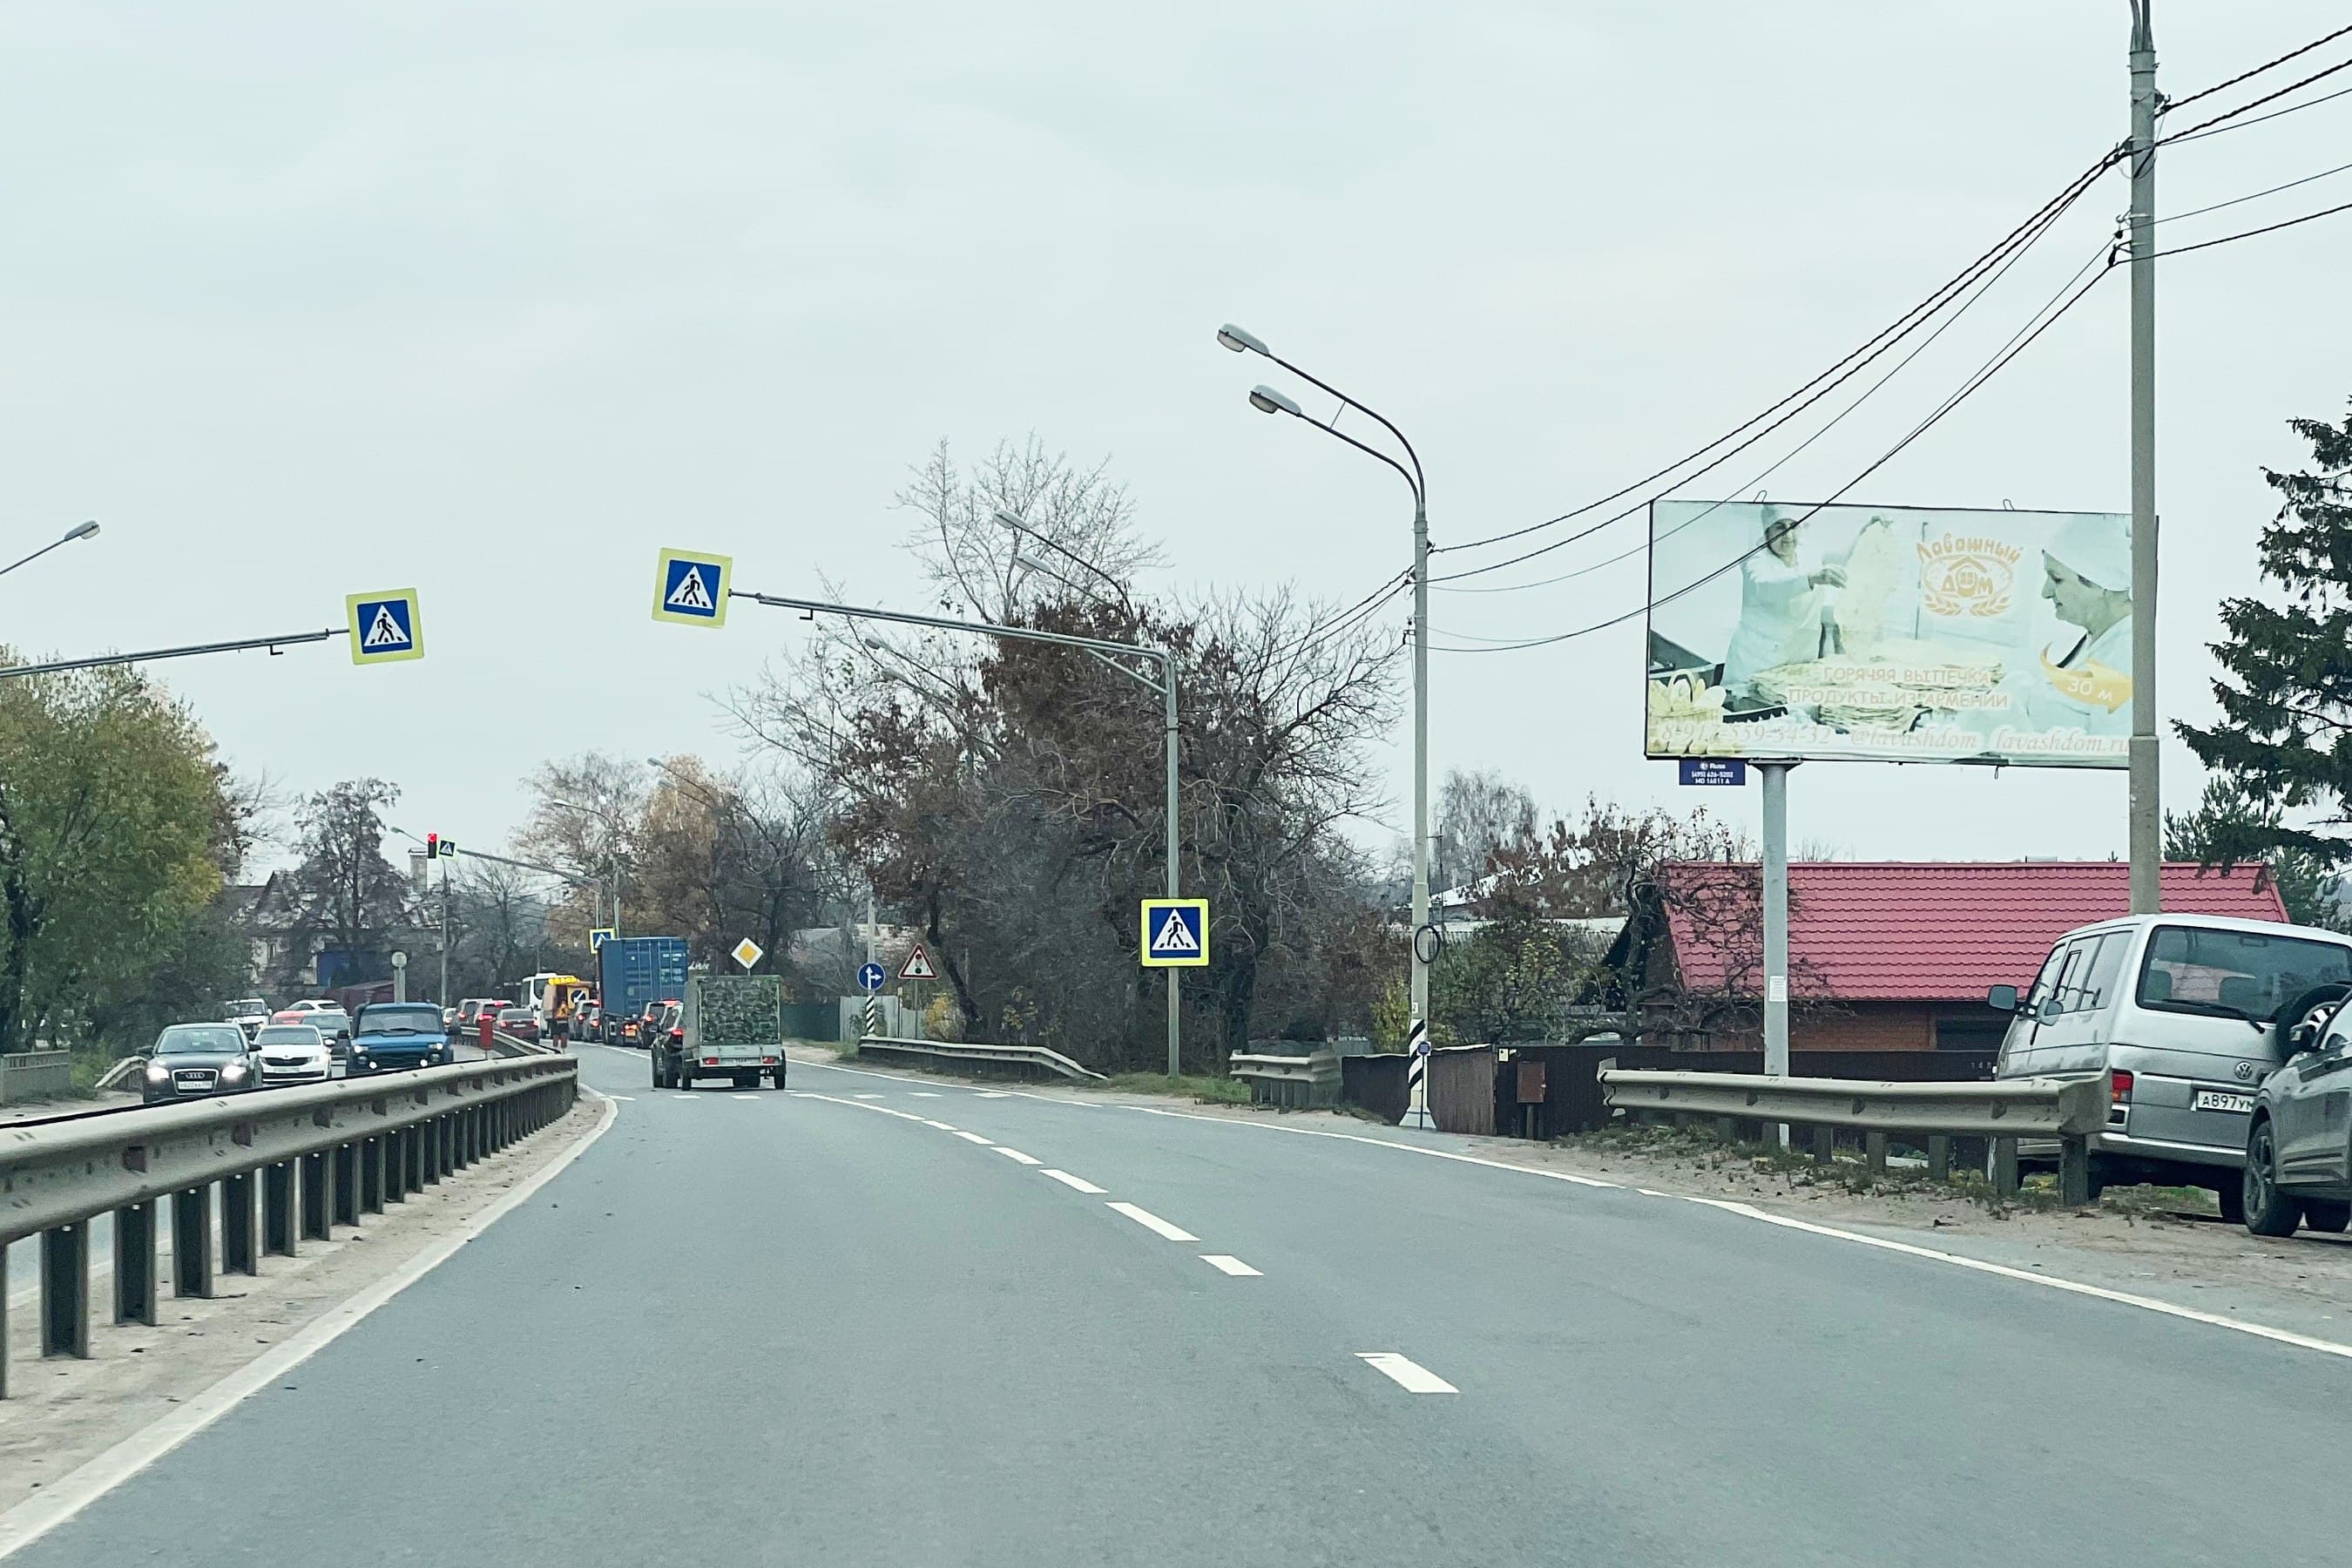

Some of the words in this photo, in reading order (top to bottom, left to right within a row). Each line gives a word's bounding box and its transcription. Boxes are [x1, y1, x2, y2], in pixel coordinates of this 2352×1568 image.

[1916, 532, 2023, 564] Лавашный
[1904, 669, 1989, 684] ВЫПЕЧКА
[2067, 677, 2092, 695] 30
[1788, 689, 1887, 704] ПРОДУКТЫ
[1925, 694, 2006, 707] АРМЕНИИ
[1996, 729, 2128, 753] lavashdom.ru
